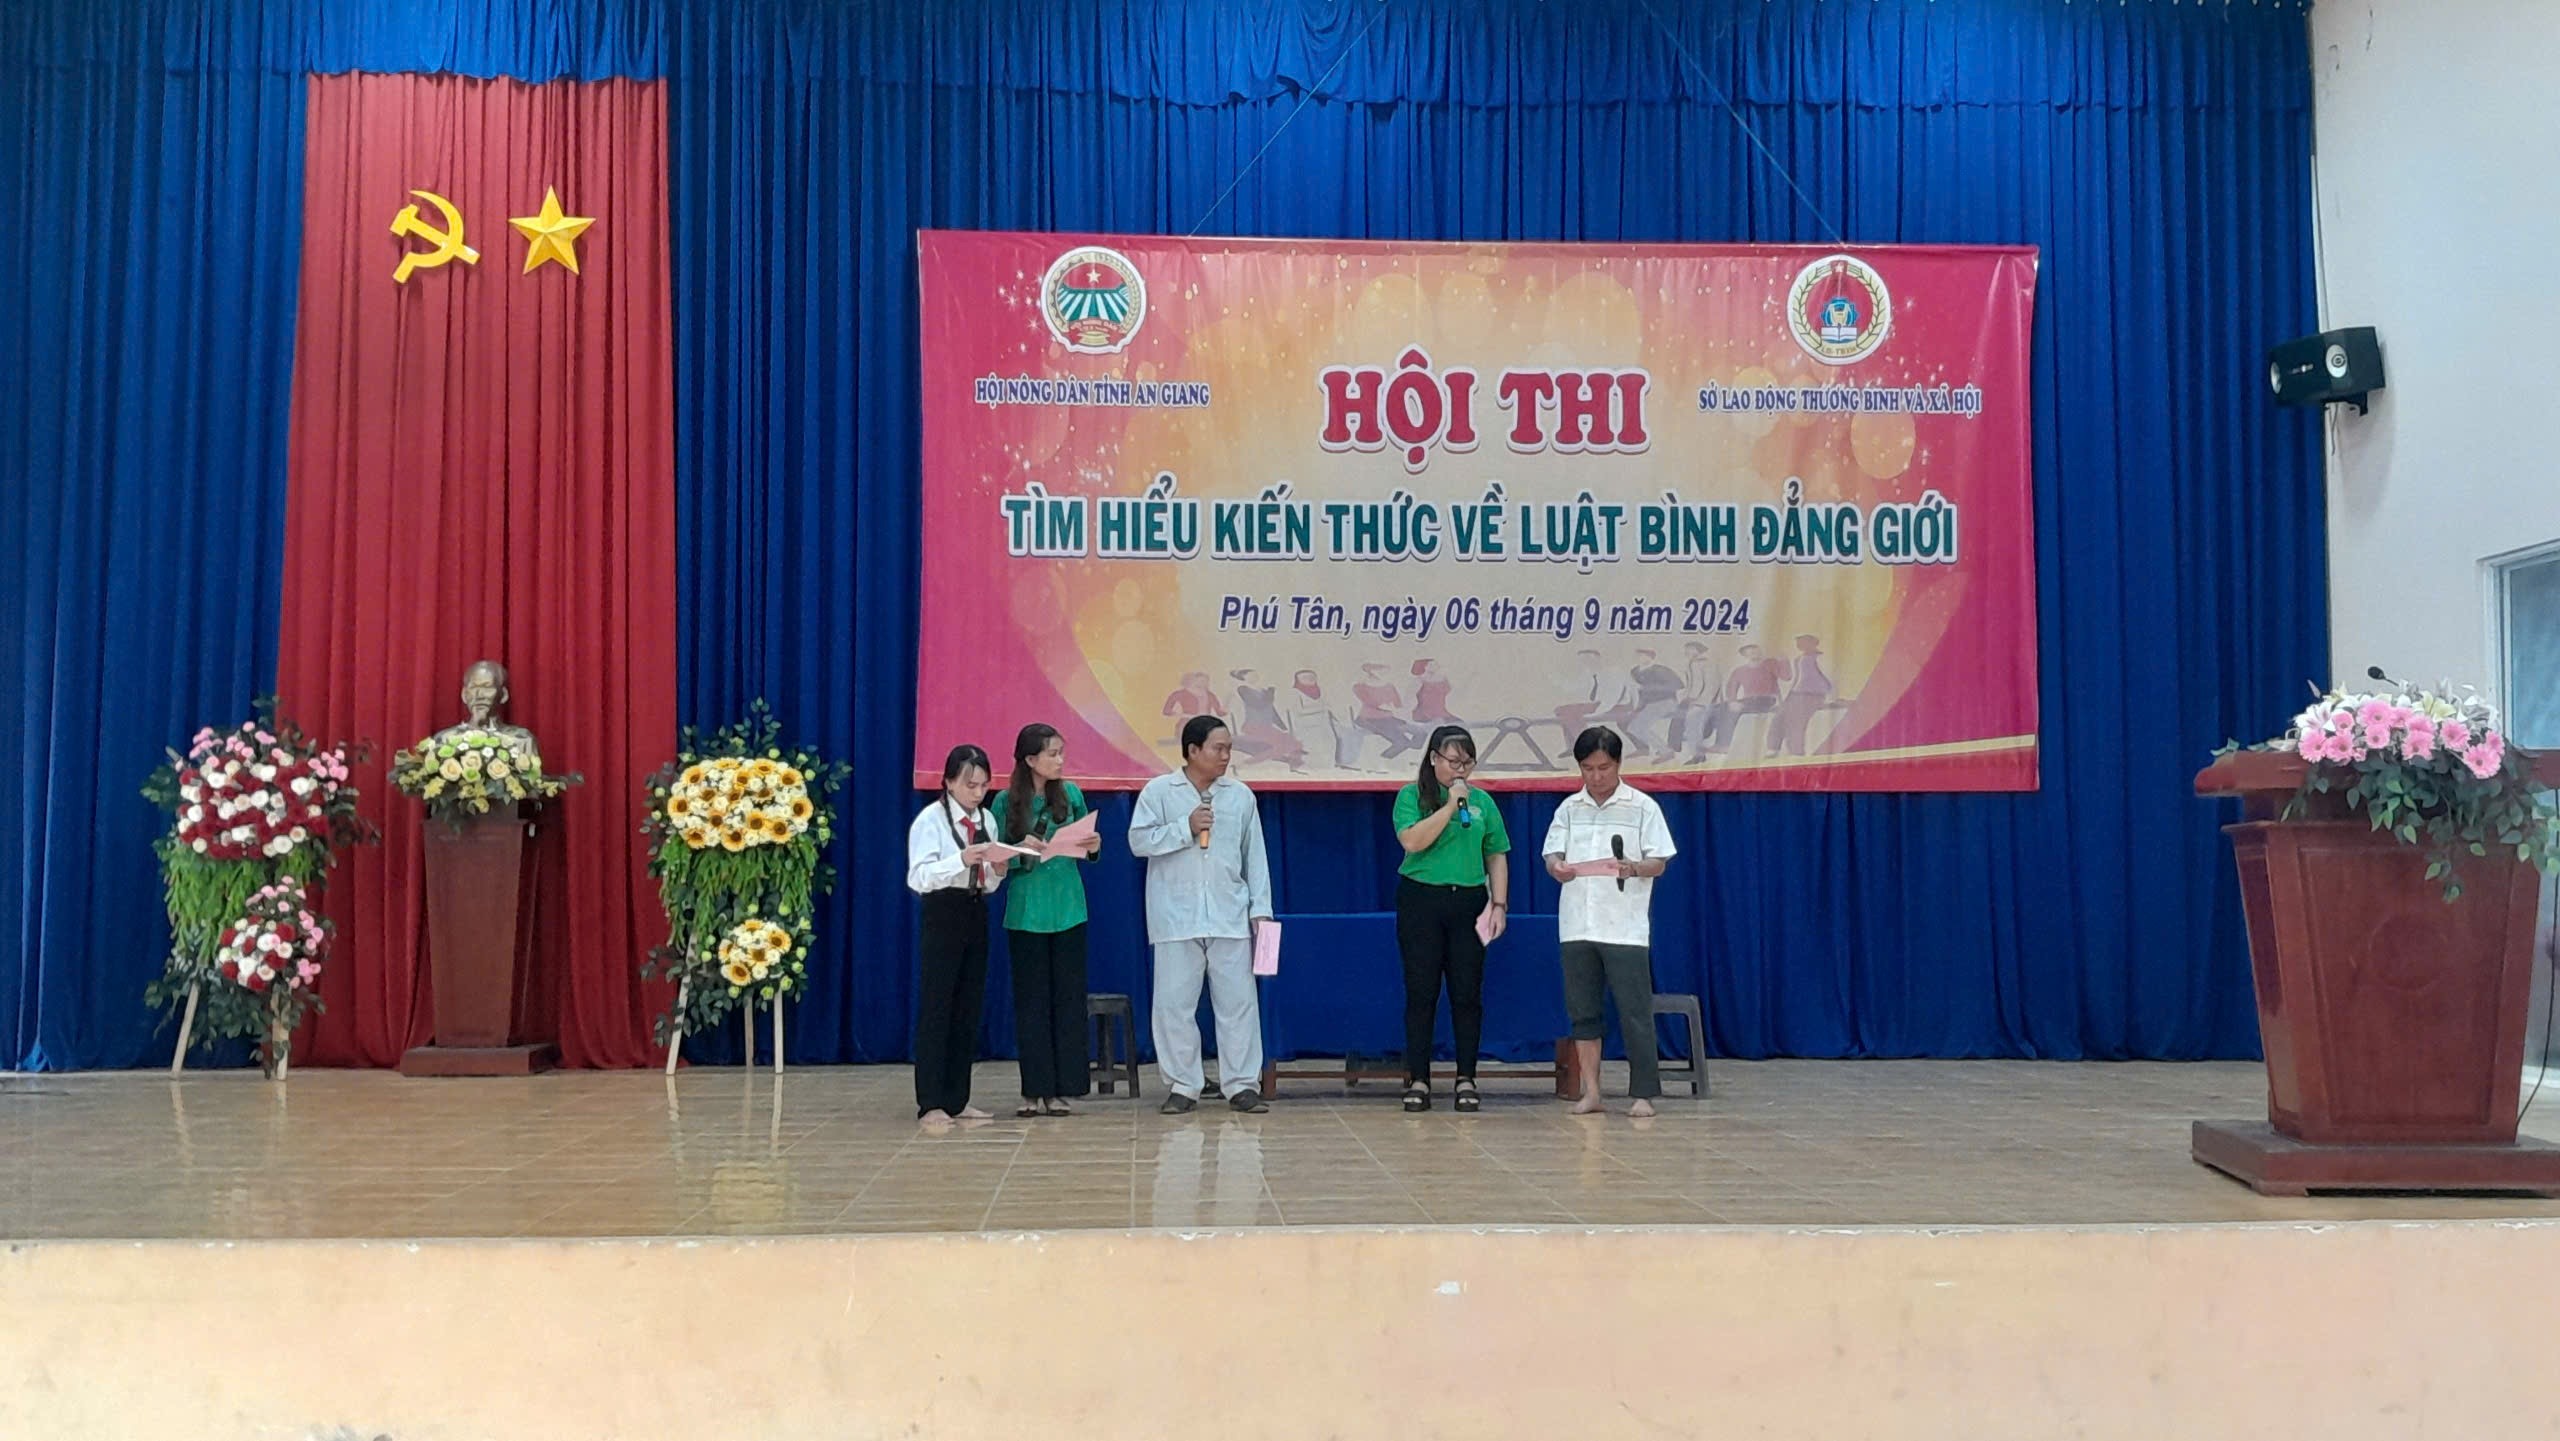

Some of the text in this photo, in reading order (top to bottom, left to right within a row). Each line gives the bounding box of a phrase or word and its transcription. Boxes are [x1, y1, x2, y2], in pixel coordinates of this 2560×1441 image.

[976, 374, 1210, 407] HỘI NÔNG DÂN TỈNH AN GIANG
[1322, 348, 1648, 466] HỘI THI
[1699, 380, 1981, 417] SỞ LAO ĐỘNG THƯƠNG BINH VÀ XÃ HỘI
[1004, 475, 1954, 567] TÌM HIỂU KIẾN THỨC VỀ LUẬT BÌNH ĐẲNG GIỚI
[1220, 595, 1750, 640] Phú Tân, ngày 06 tháng 9 năm 2024
